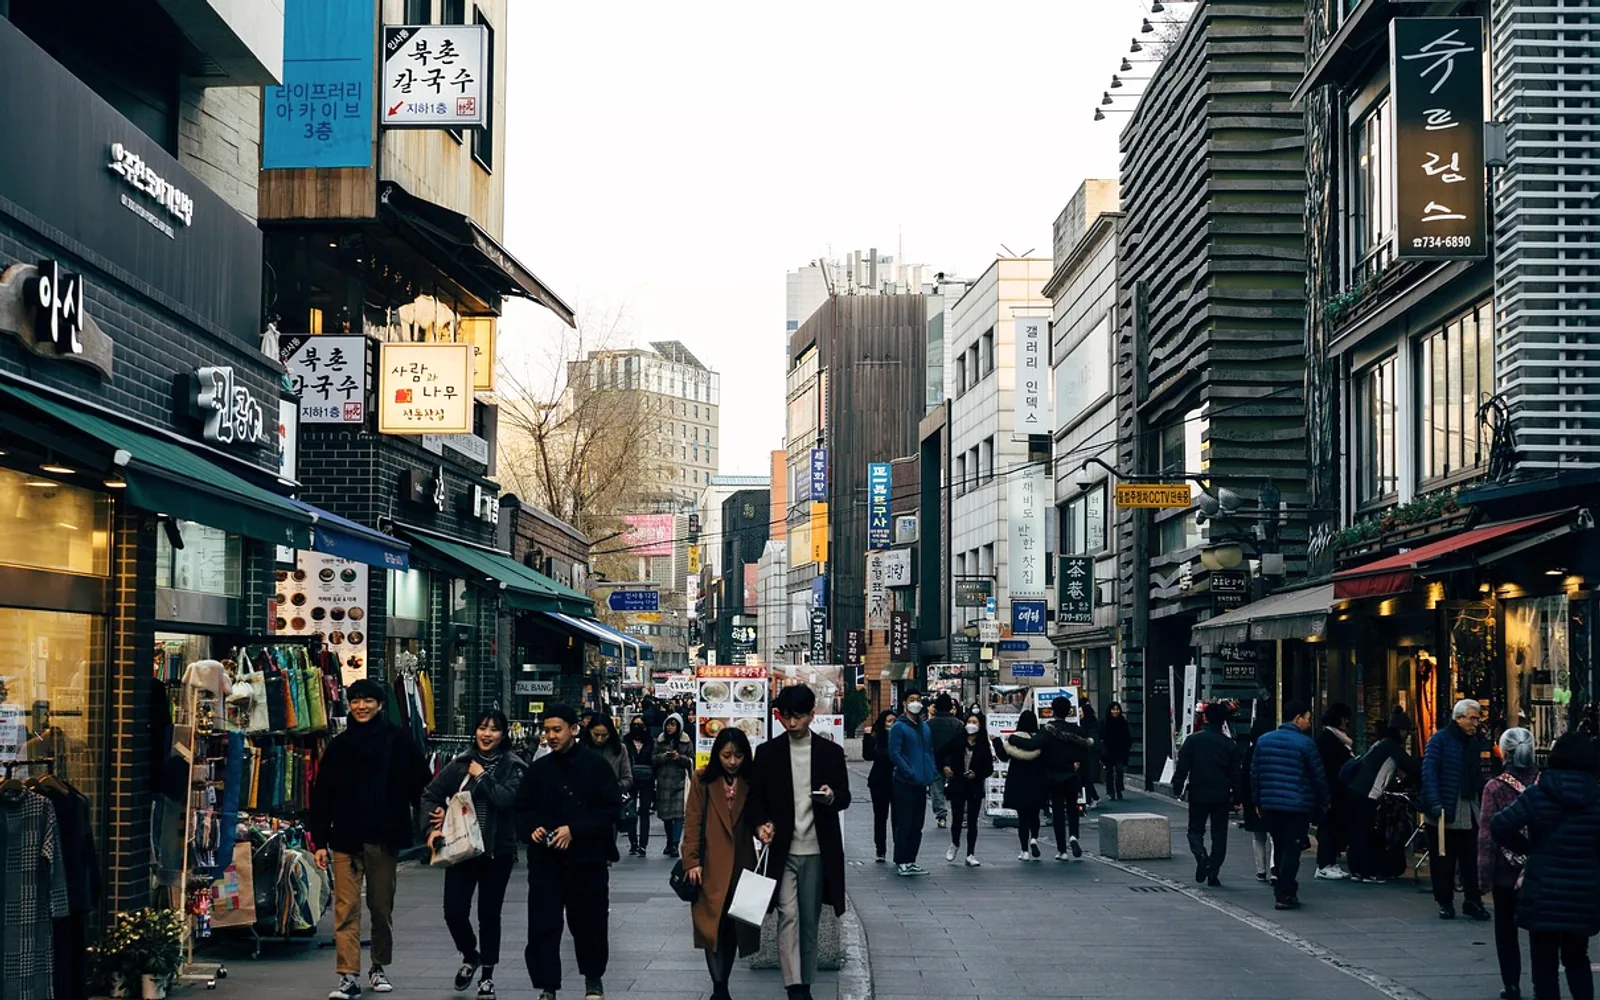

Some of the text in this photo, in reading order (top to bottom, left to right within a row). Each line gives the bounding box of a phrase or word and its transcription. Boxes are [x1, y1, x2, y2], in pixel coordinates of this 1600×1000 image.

[408, 39, 459, 66] 북촌
[392, 68, 475, 94] 칼국수
[276, 82, 361, 101] 라이프러리
[276, 101, 361, 121] 아카이브
[407, 102, 447, 114] 지하1층
[304, 121, 332, 141] 3층
[1423, 236, 1471, 247] 734-6890
[299, 346, 348, 372] 북촌
[1025, 325, 1038, 423] 갤러리 인덱스
[423, 385, 458, 400] 나무
[302, 406, 340, 418] 지하1층
[516, 684, 552, 693] TAL BANG
